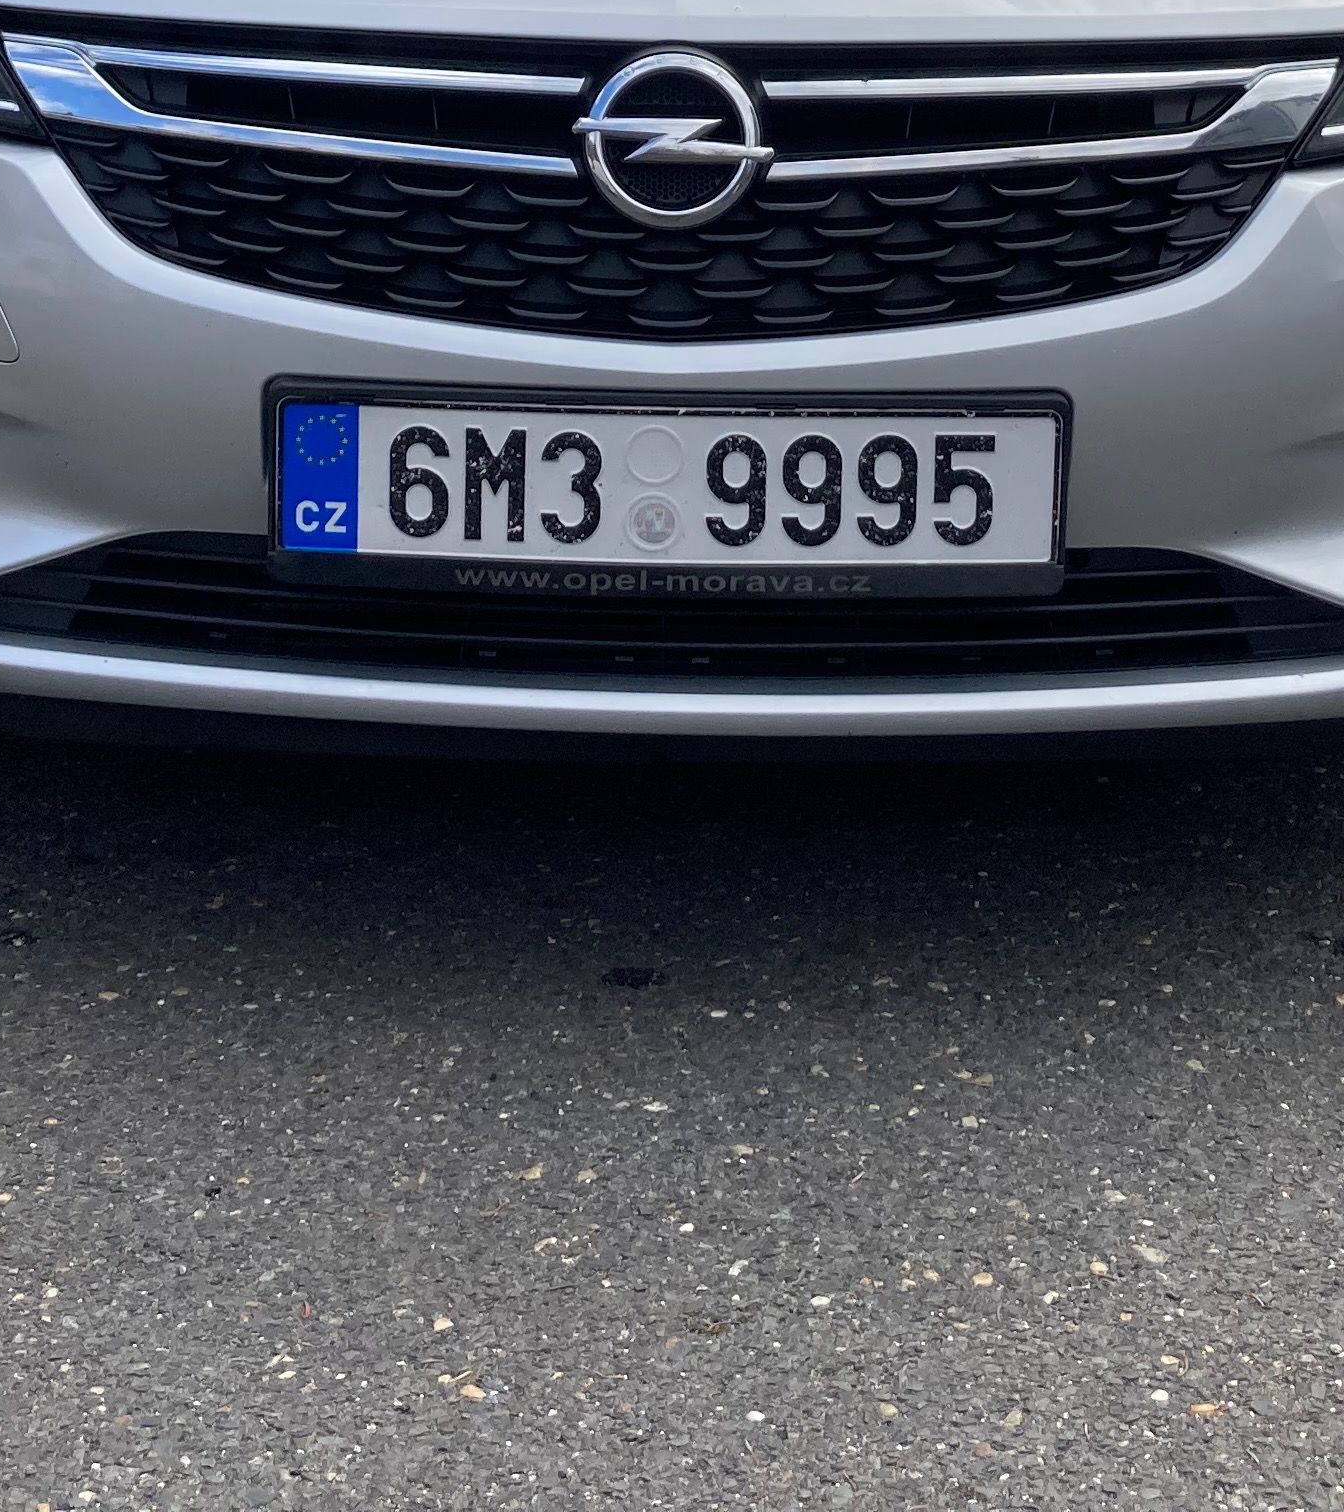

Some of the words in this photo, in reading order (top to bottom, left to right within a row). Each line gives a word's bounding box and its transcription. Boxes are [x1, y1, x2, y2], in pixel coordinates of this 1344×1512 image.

[389, 425, 602, 544] 6M3
[705, 433, 996, 547] 9995
[295, 500, 346, 533] CZ
[456, 568, 872, 596] www.opel-morava.cz
